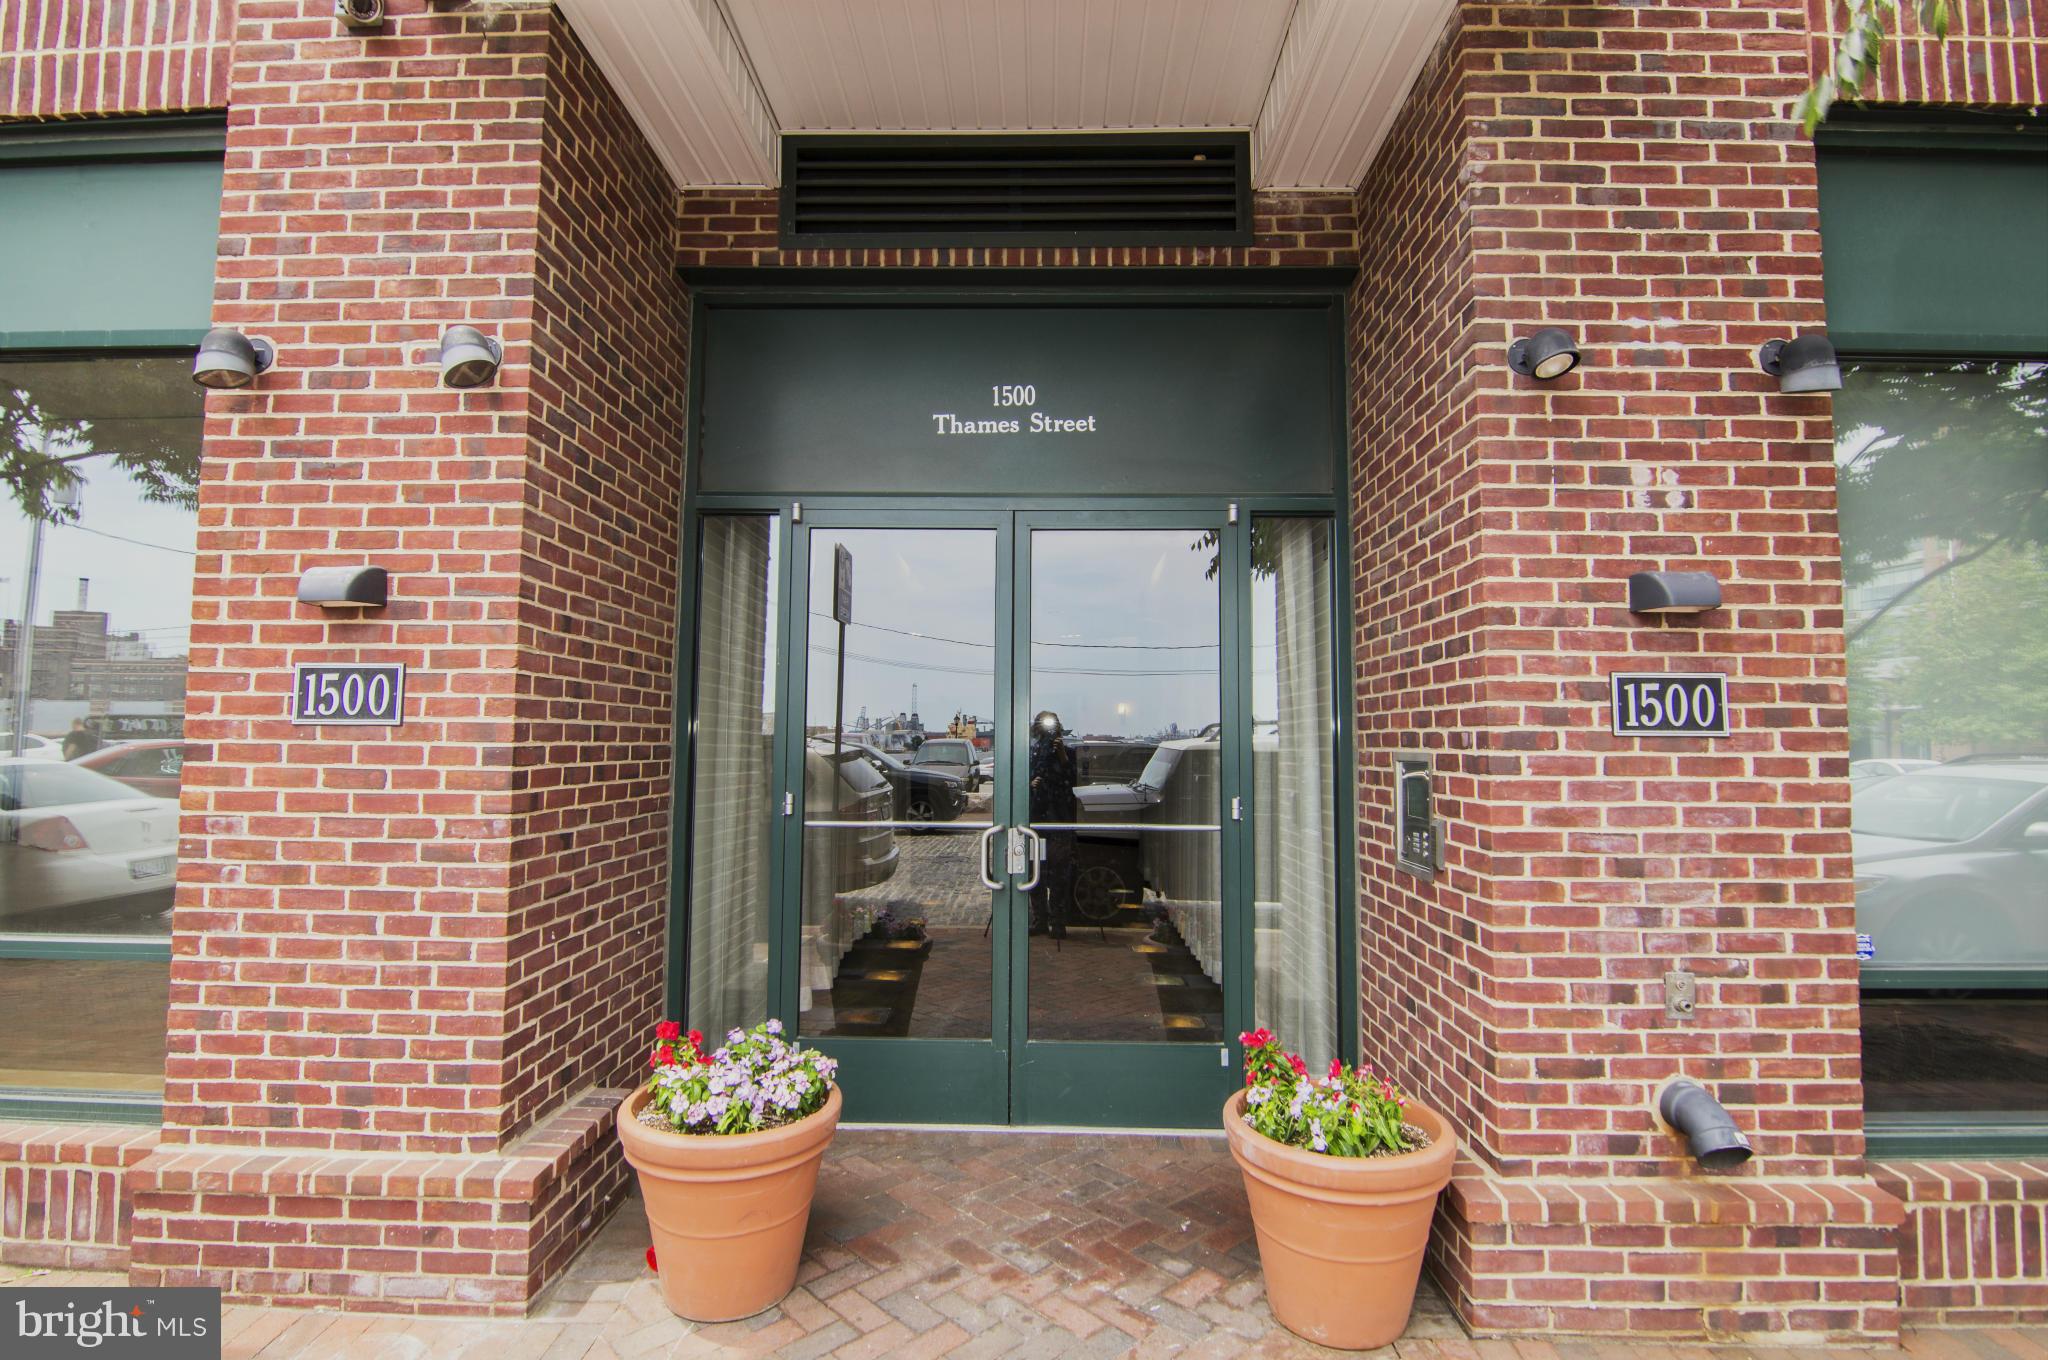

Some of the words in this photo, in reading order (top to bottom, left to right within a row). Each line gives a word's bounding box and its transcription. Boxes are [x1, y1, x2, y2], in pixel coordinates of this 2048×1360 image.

[992, 385, 1036, 406] 1500
[932, 413, 1020, 434] Thames
[1030, 412, 1097, 433] Street
[303, 673, 390, 716] 1500
[1623, 683, 1716, 727] 1500
